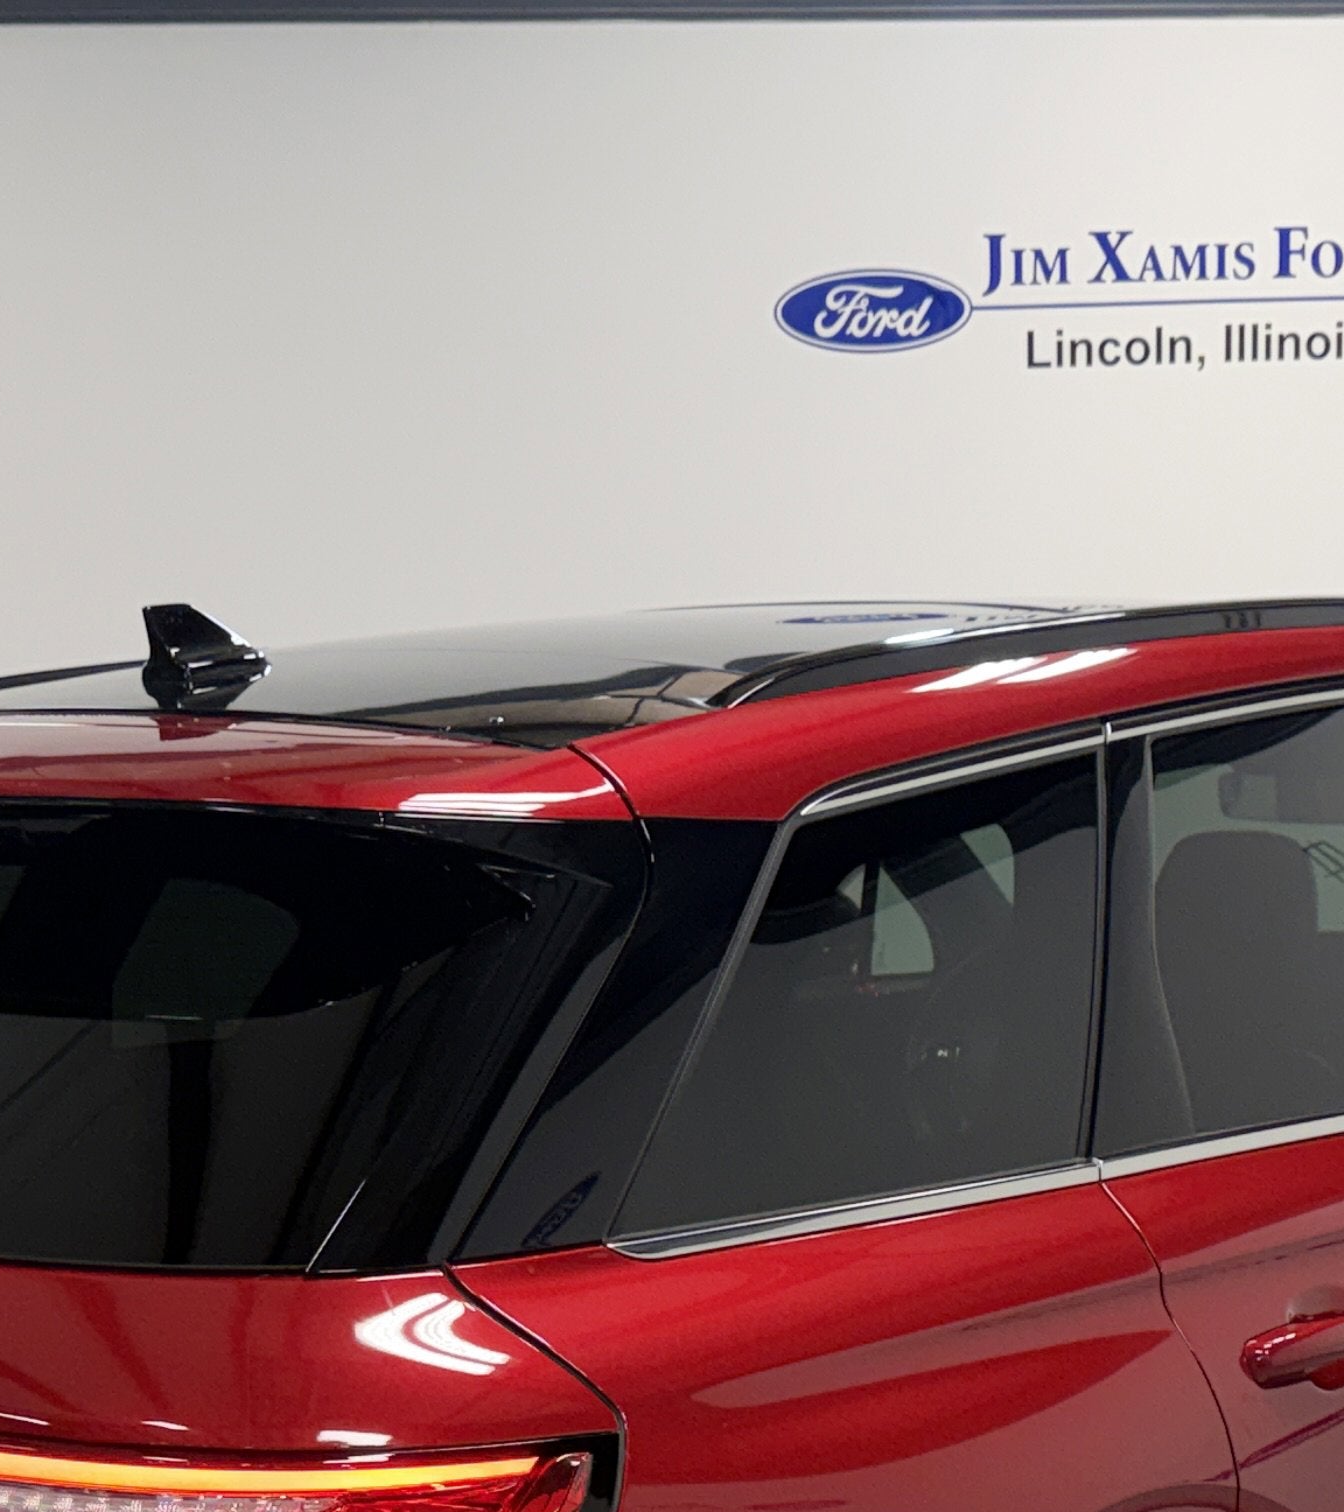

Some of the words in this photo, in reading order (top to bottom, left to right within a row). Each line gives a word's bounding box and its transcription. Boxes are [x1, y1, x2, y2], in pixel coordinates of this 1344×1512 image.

[982, 234, 1070, 297] JIM
[1087, 230, 1256, 284] XAMIS
[813, 283, 930, 339] Ford
[1027, 326, 1205, 370] Lincoln,
